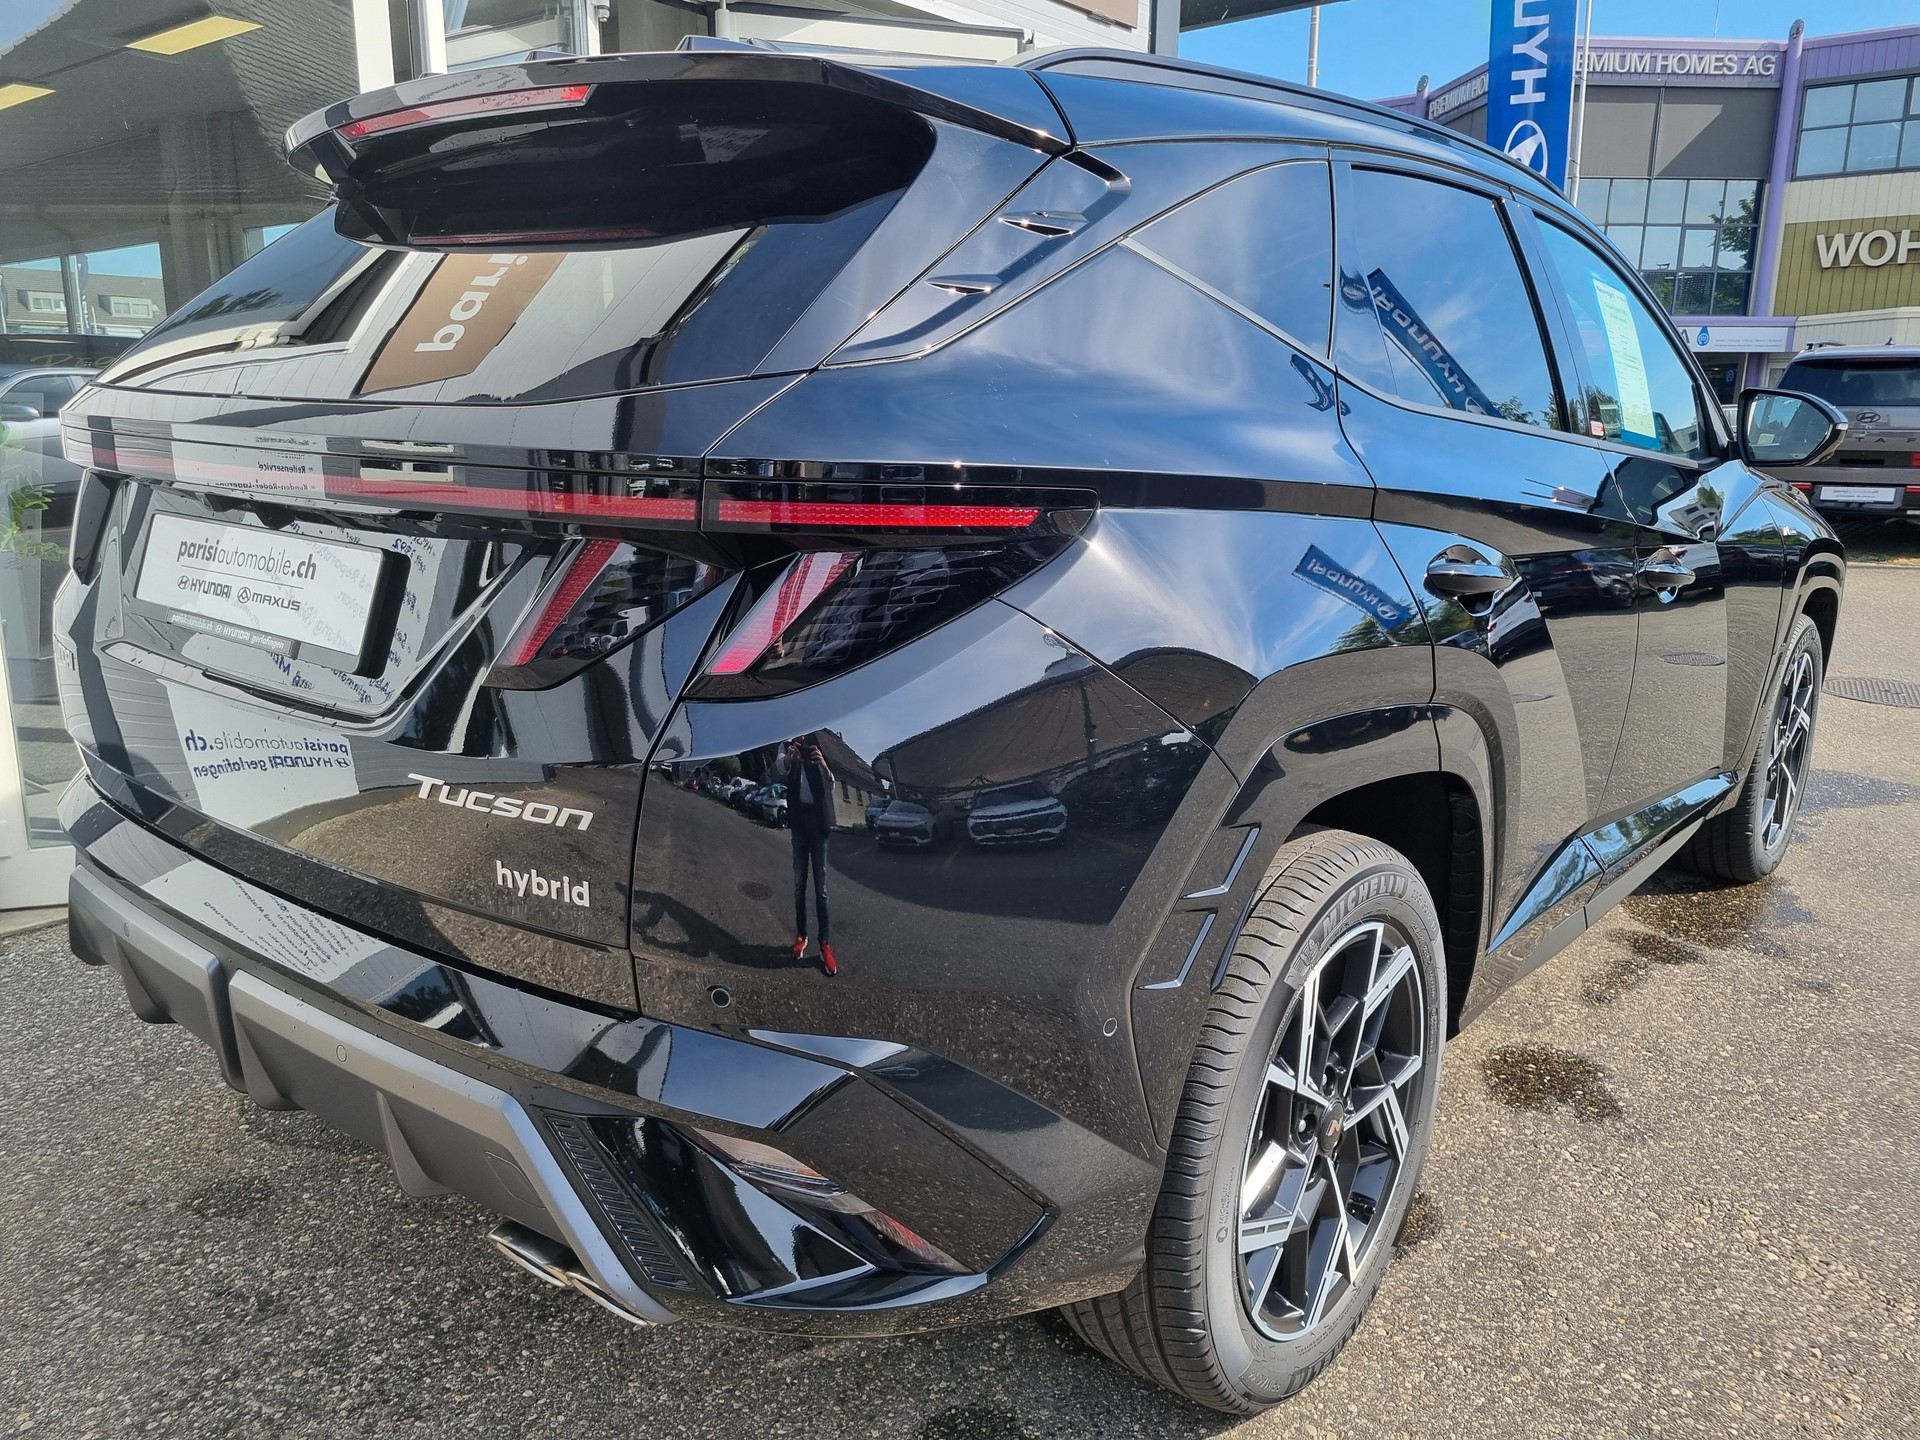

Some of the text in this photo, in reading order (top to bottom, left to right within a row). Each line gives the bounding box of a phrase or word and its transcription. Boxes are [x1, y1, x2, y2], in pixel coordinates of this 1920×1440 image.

[1576, 52, 1778, 76] EMIUM HOMES AG
[1429, 74, 1488, 120] PREMIUM HO
[1371, 285, 1466, 394] HYUNDAI
[177, 536, 317, 581] parisiautomobile.ch
[1306, 558, 1380, 605] HYUNDAI
[190, 578, 302, 612] HYUNDAI MAXUS
[223, 626, 251, 641] HYUNDAI
[251, 635, 285, 649] gerlafingen
[496, 859, 591, 908] hybrid
[1322, 875, 1407, 939] MICHELIN
